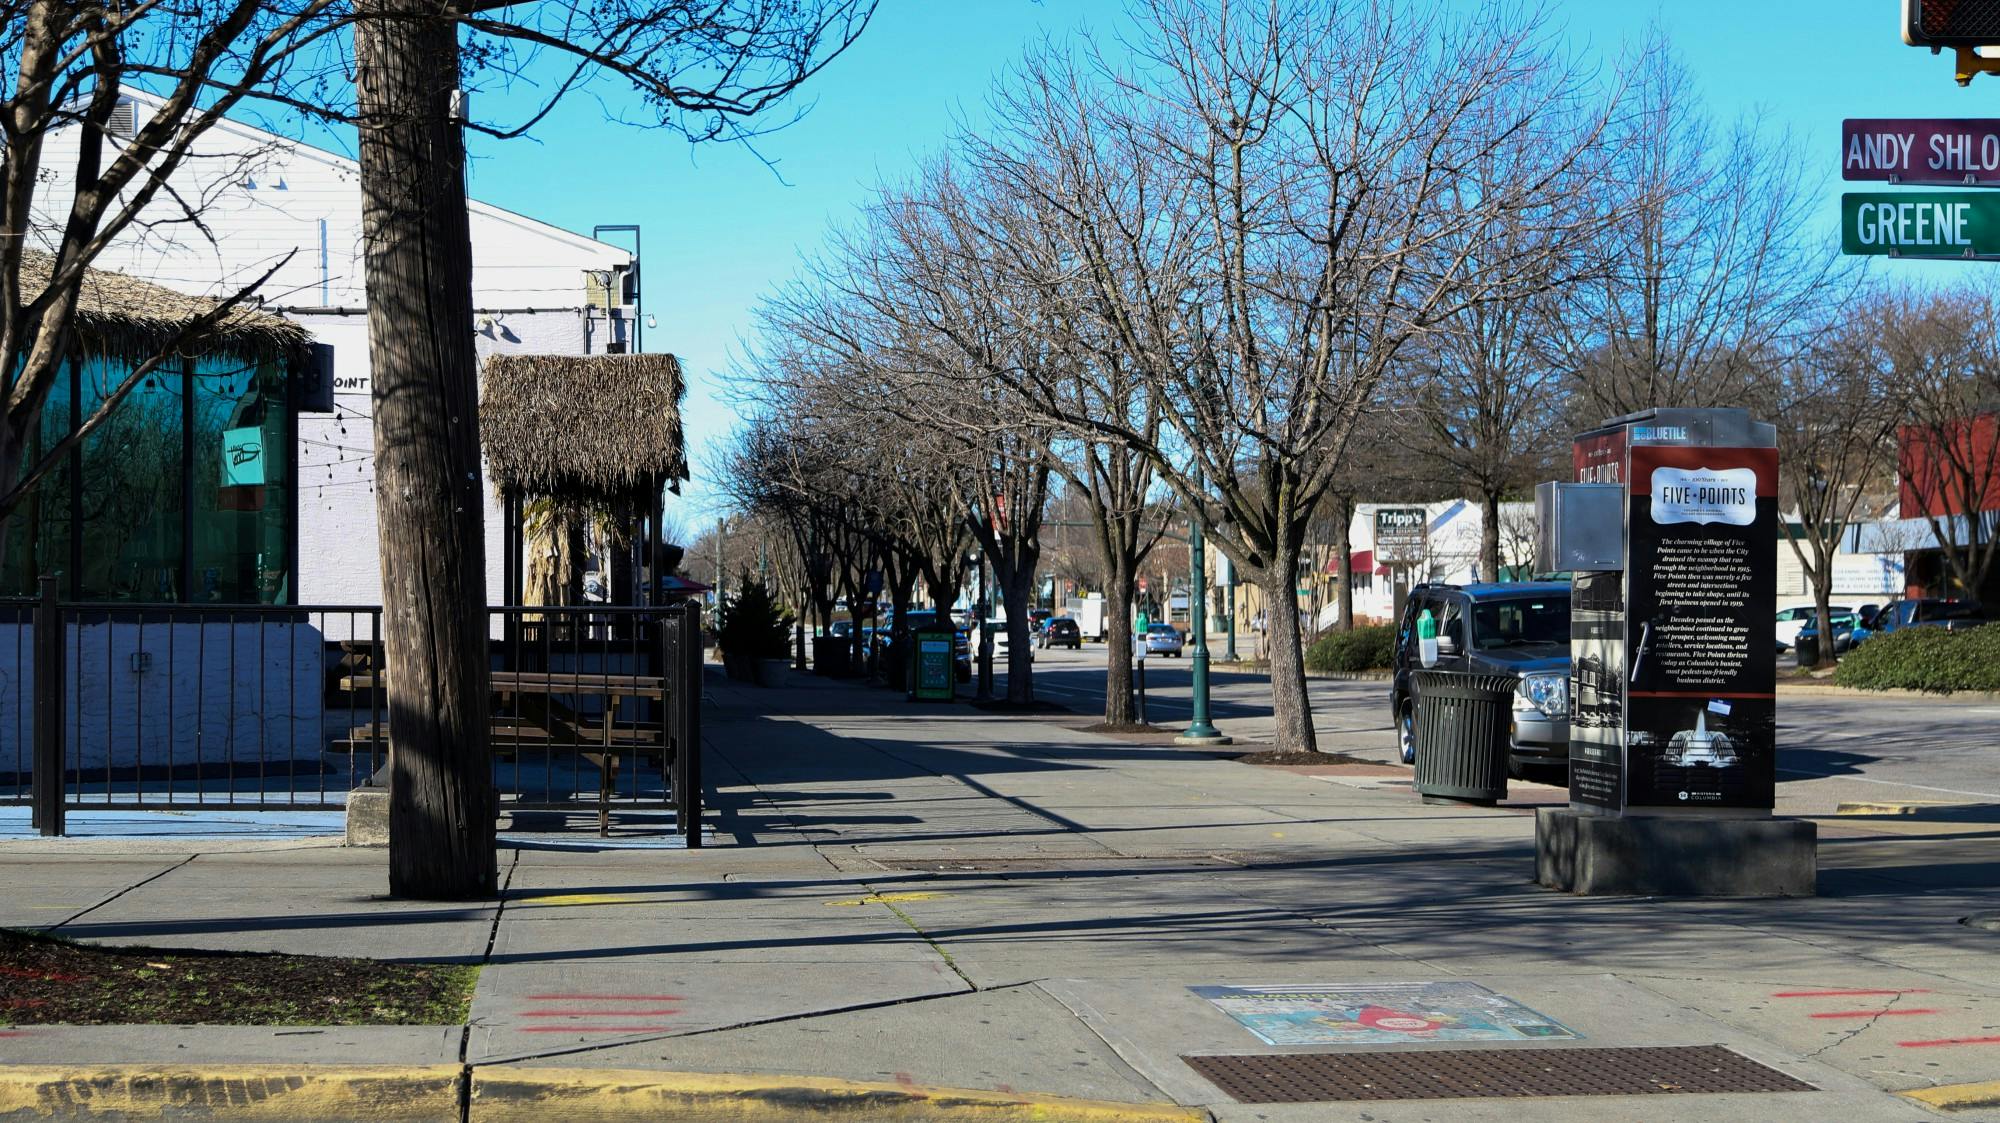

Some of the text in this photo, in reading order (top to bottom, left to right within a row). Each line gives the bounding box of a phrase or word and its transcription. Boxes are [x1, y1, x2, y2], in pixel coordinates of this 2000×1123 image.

[1846, 133, 1915, 170] ANDY
[1858, 202, 1971, 245] GREENE
[1646, 427, 1687, 440] BLUETILE
[1663, 487, 1745, 505] FIVE POINTS
[1380, 512, 1422, 526] Tripp's
